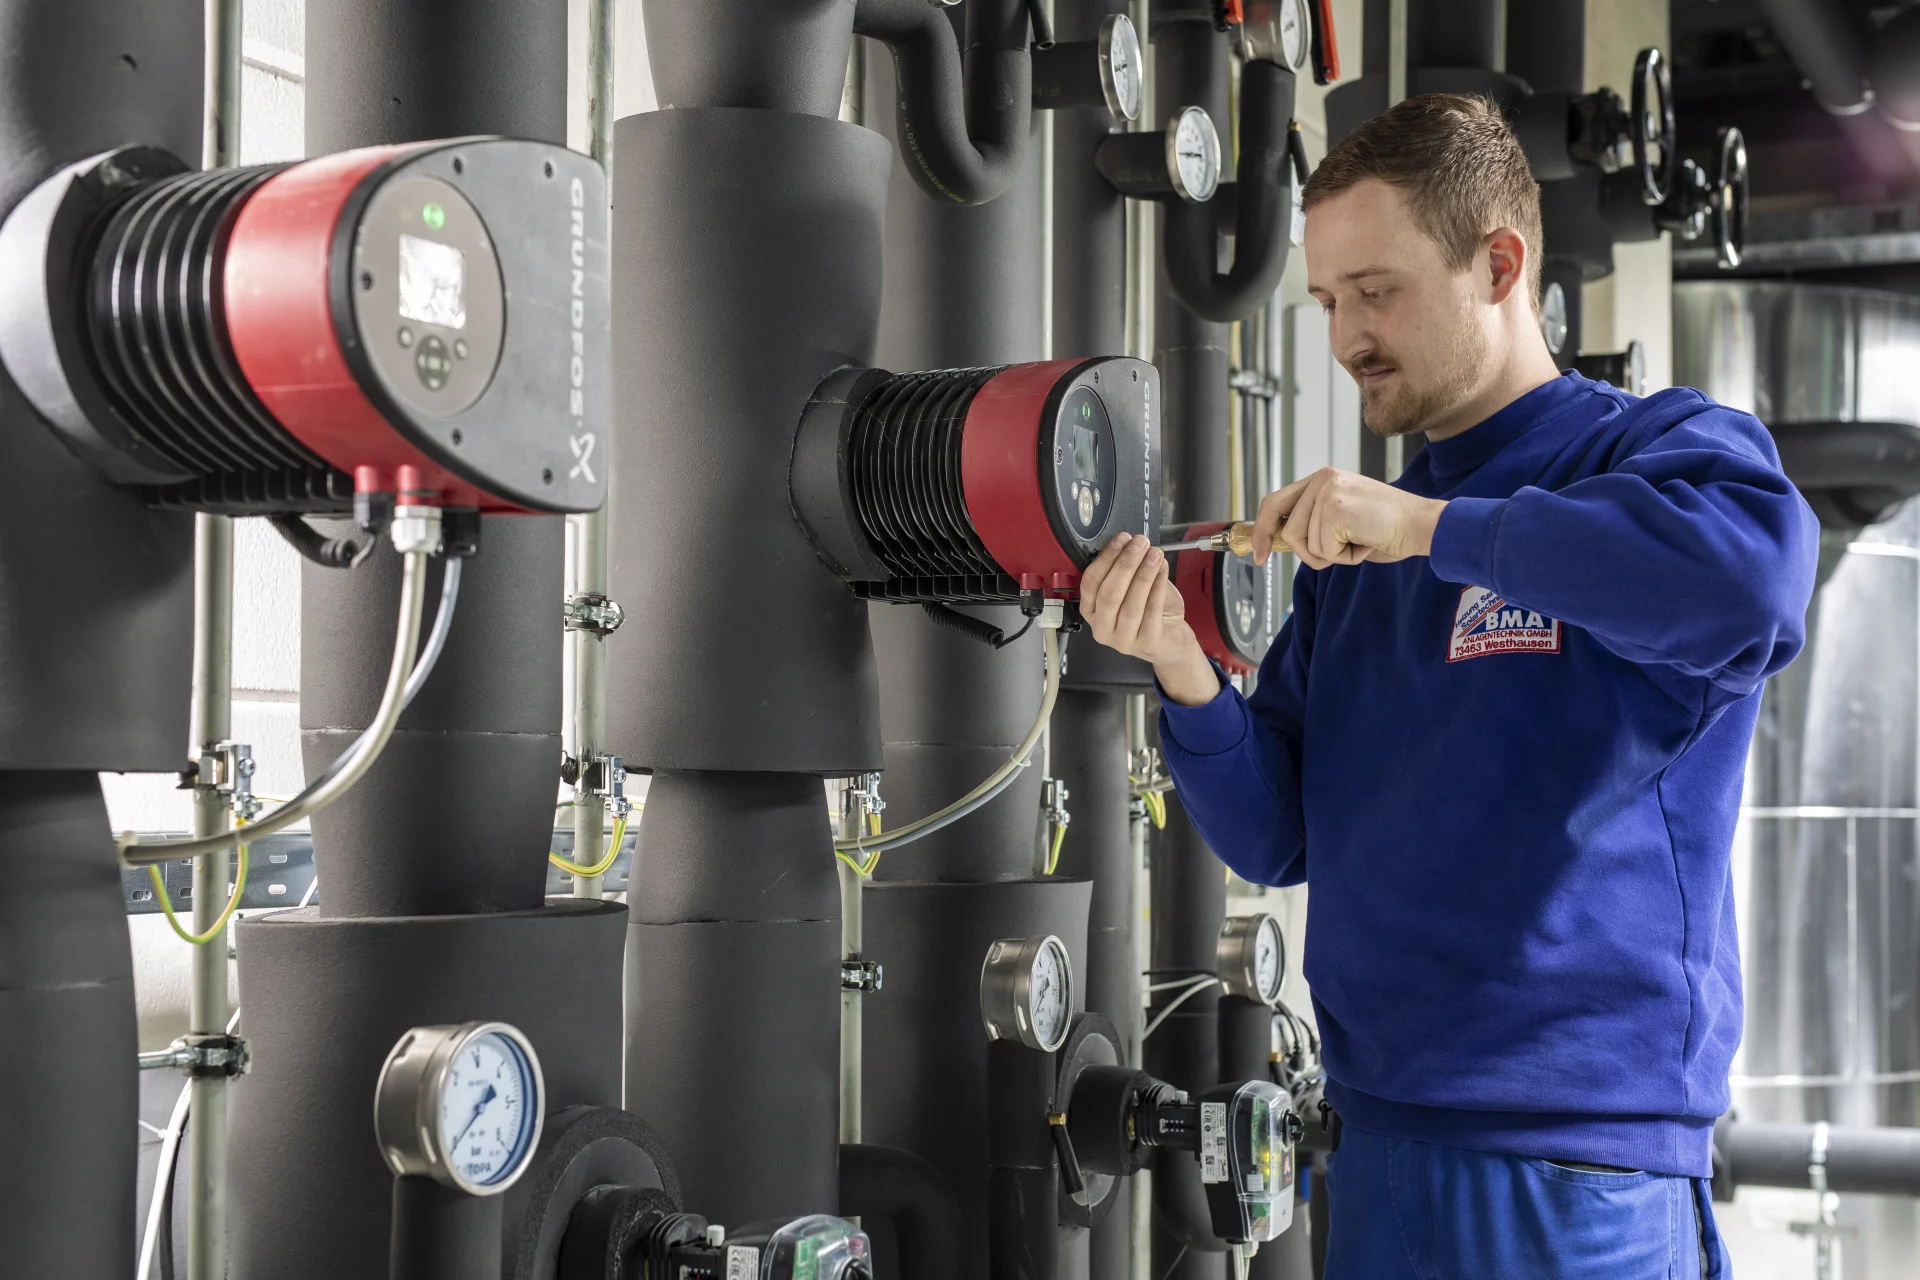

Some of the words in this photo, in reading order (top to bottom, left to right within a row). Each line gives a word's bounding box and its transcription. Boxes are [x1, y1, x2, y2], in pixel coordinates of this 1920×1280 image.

[570, 177, 584, 416] GRUNDFOS
[1486, 609, 1545, 631] BMA
[1455, 643, 1482, 656] 73463
[1484, 638, 1552, 650] Westhausen
[1462, 629, 1525, 645] ANLAGENTECHNIK
[1526, 630, 1552, 638] GMBH
